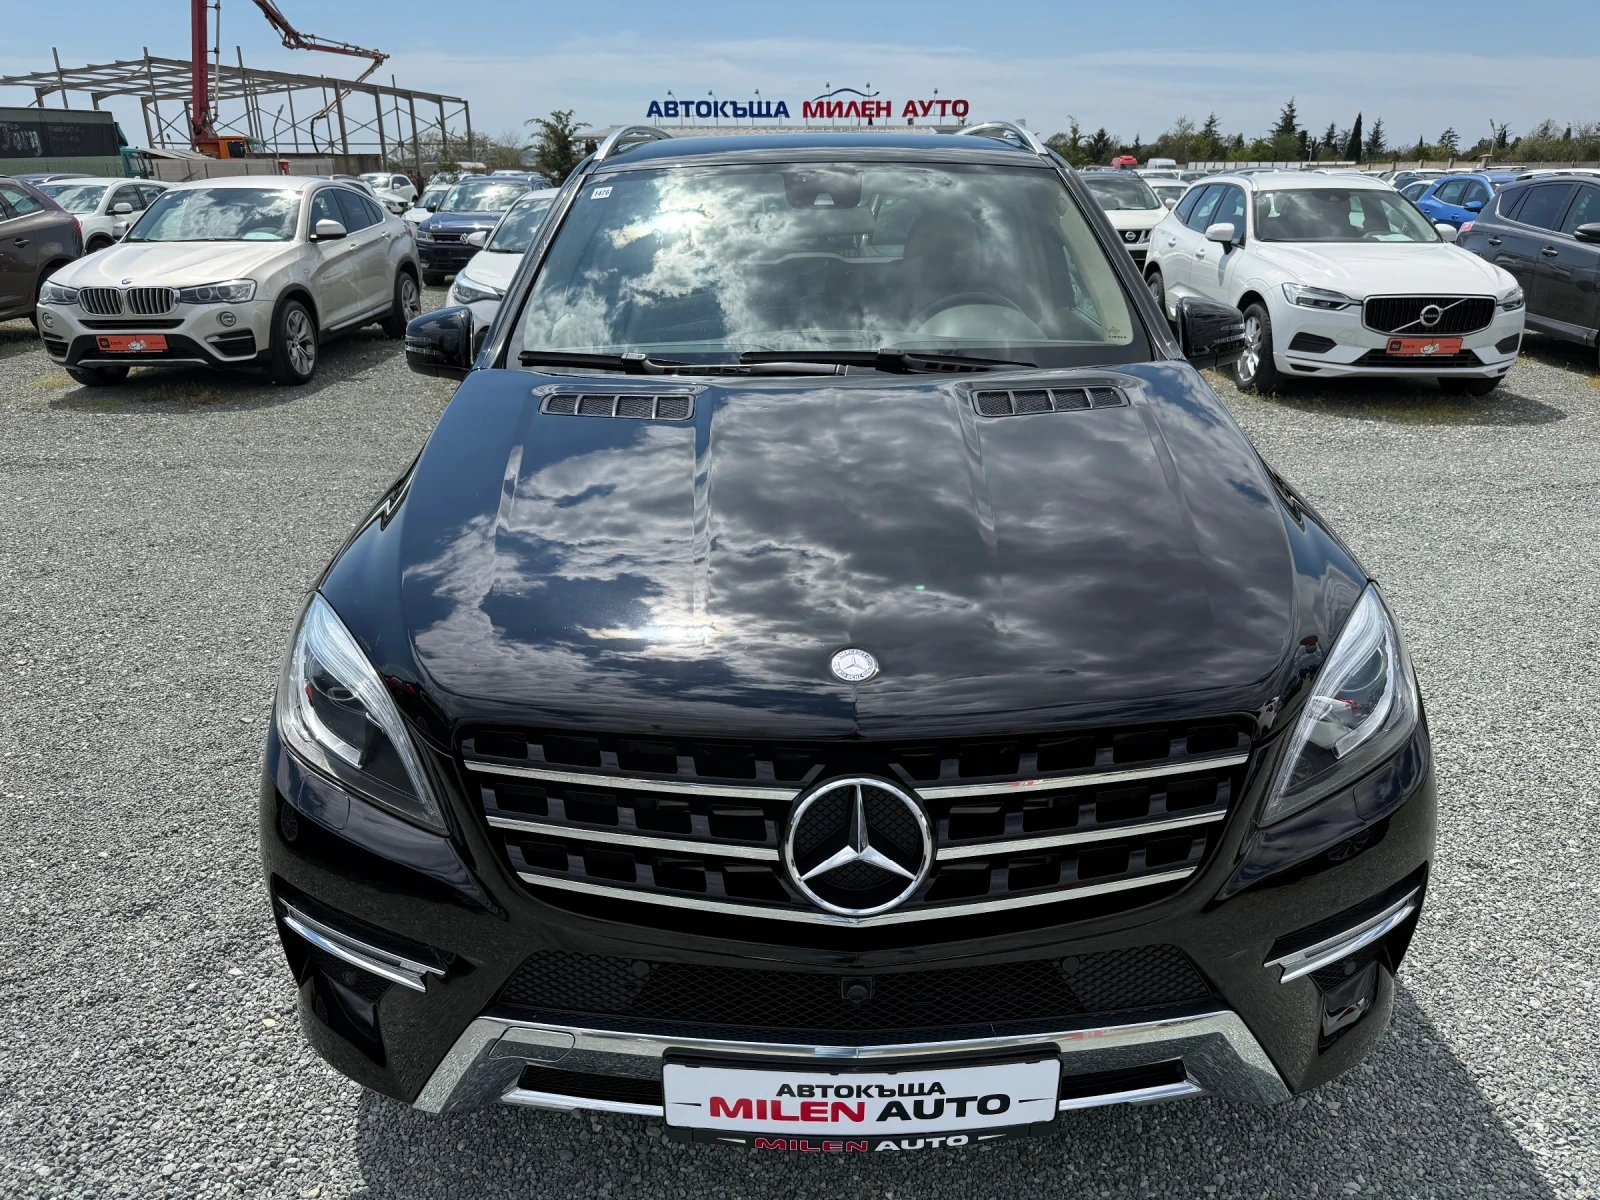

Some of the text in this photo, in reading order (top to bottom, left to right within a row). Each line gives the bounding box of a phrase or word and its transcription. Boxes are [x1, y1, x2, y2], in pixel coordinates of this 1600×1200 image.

[646, 99, 969, 118] АВТОКЪЩА МИЛЕН АУТО
[776, 1081, 946, 1099] АВТОКЪЩА
[709, 1093, 1011, 1122] MILEN AUTO
[754, 1134, 969, 1152] MILEN AUTO
